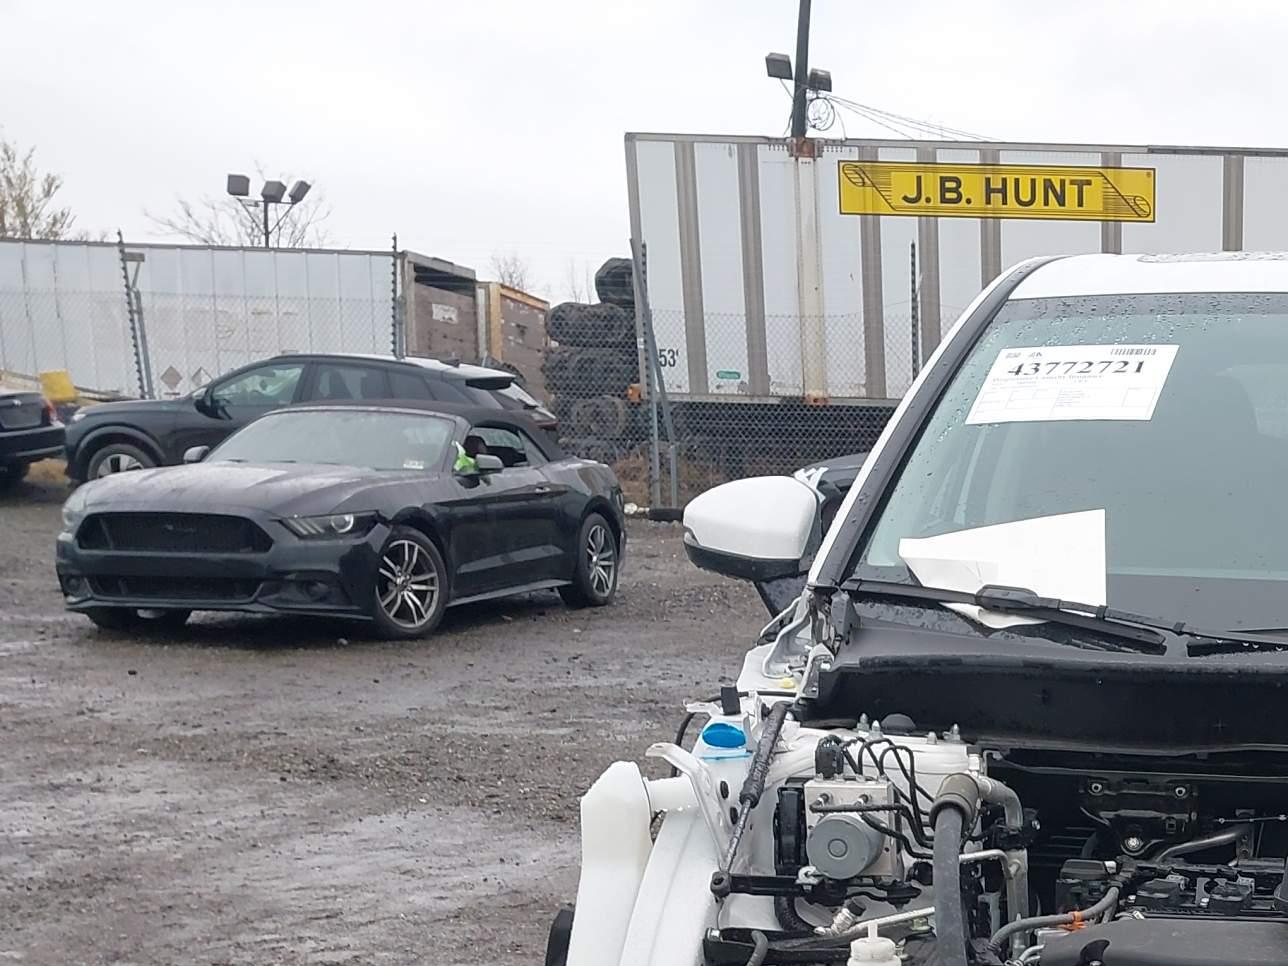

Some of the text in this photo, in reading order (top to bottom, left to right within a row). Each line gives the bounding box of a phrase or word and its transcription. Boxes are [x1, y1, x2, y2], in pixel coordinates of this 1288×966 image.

[902, 175, 1092, 208] J.B. HUNT
[1008, 360, 1145, 376] 43772721
